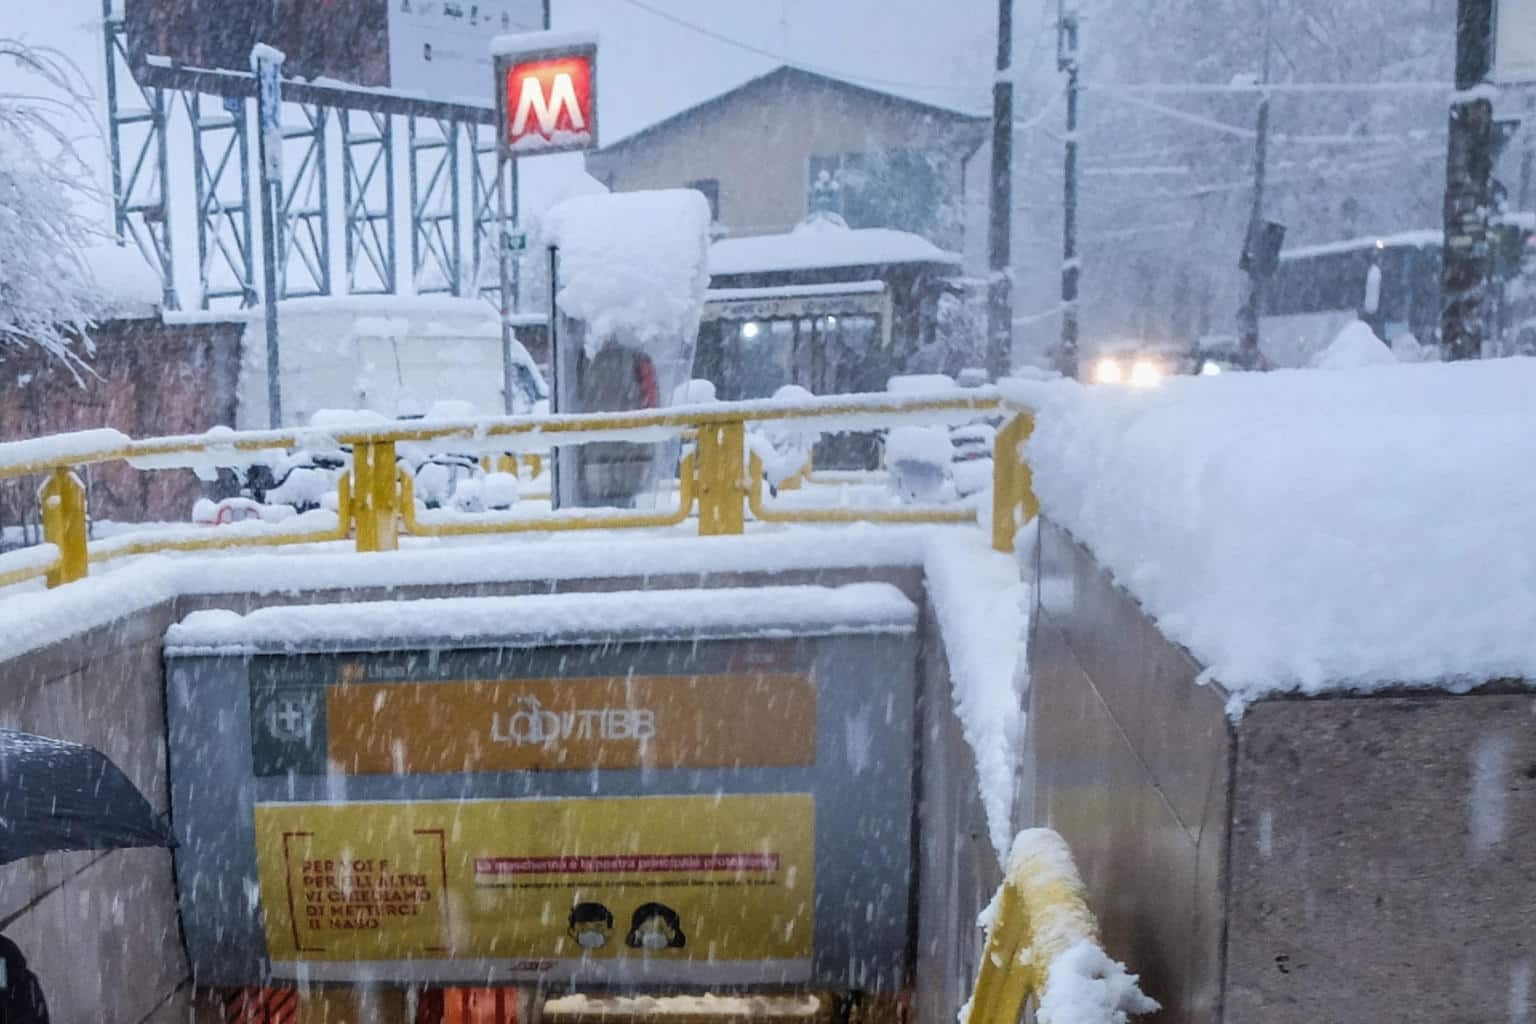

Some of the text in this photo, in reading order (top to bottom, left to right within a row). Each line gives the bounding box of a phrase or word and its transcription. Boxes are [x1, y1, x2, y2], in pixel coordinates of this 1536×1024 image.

[511, 73, 585, 136] M
[302, 860, 335, 873] PER
[303, 875, 336, 889] PER
